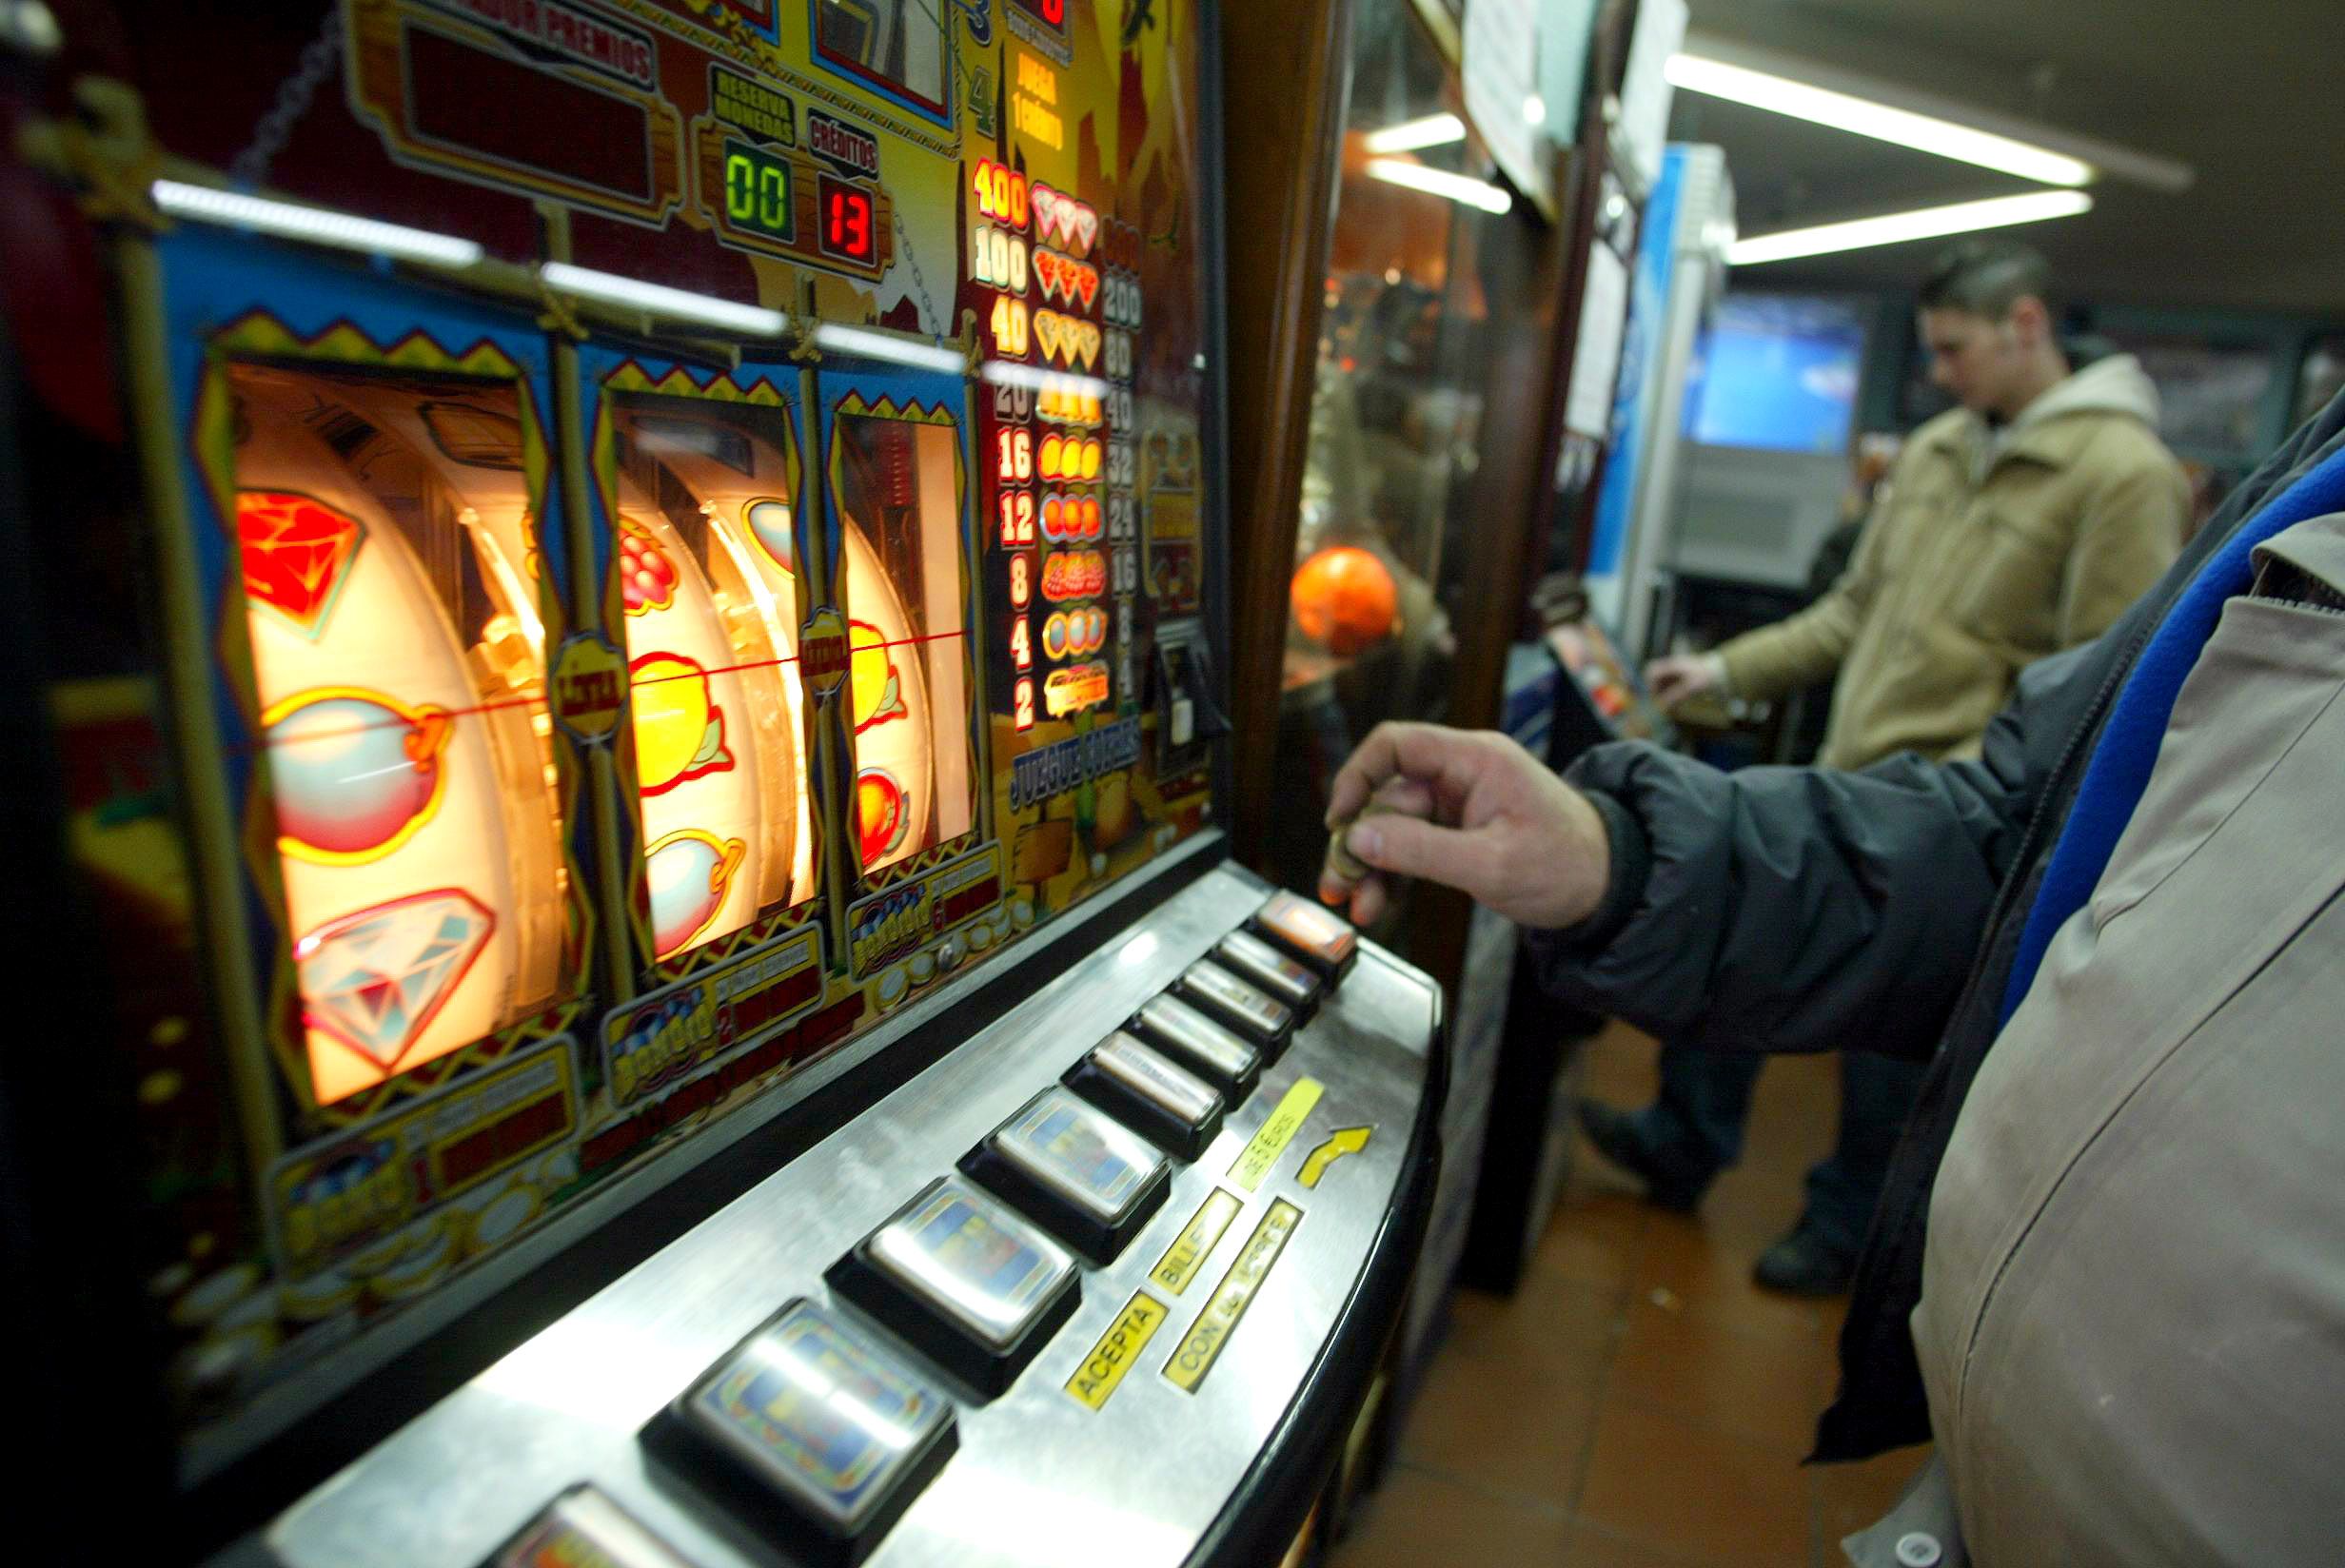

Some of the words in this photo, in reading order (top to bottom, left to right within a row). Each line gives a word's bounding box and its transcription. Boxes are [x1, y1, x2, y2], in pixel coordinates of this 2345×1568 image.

[714, 94, 795, 147] MONEDAS
[716, 70, 792, 122] RESERVA
[809, 115, 878, 174] CRÉDITOS
[727, 154, 785, 230] 00
[975, 157, 1029, 230] 400
[830, 193, 870, 255] 13
[975, 225, 1028, 296] 100
[1104, 274, 1142, 329] 200
[991, 295, 1029, 358] 40
[995, 364, 1030, 422] 20
[998, 426, 1032, 484] 16
[1107, 440, 1134, 488] 32
[999, 490, 1035, 546] 12
[1109, 495, 1135, 541] 24
[1010, 552, 1030, 610] 8
[1112, 549, 1136, 596] 16
[1011, 614, 1033, 672] 4
[1015, 676, 1035, 732] 2
[1075, 1305, 1153, 1400] ACEPTA
